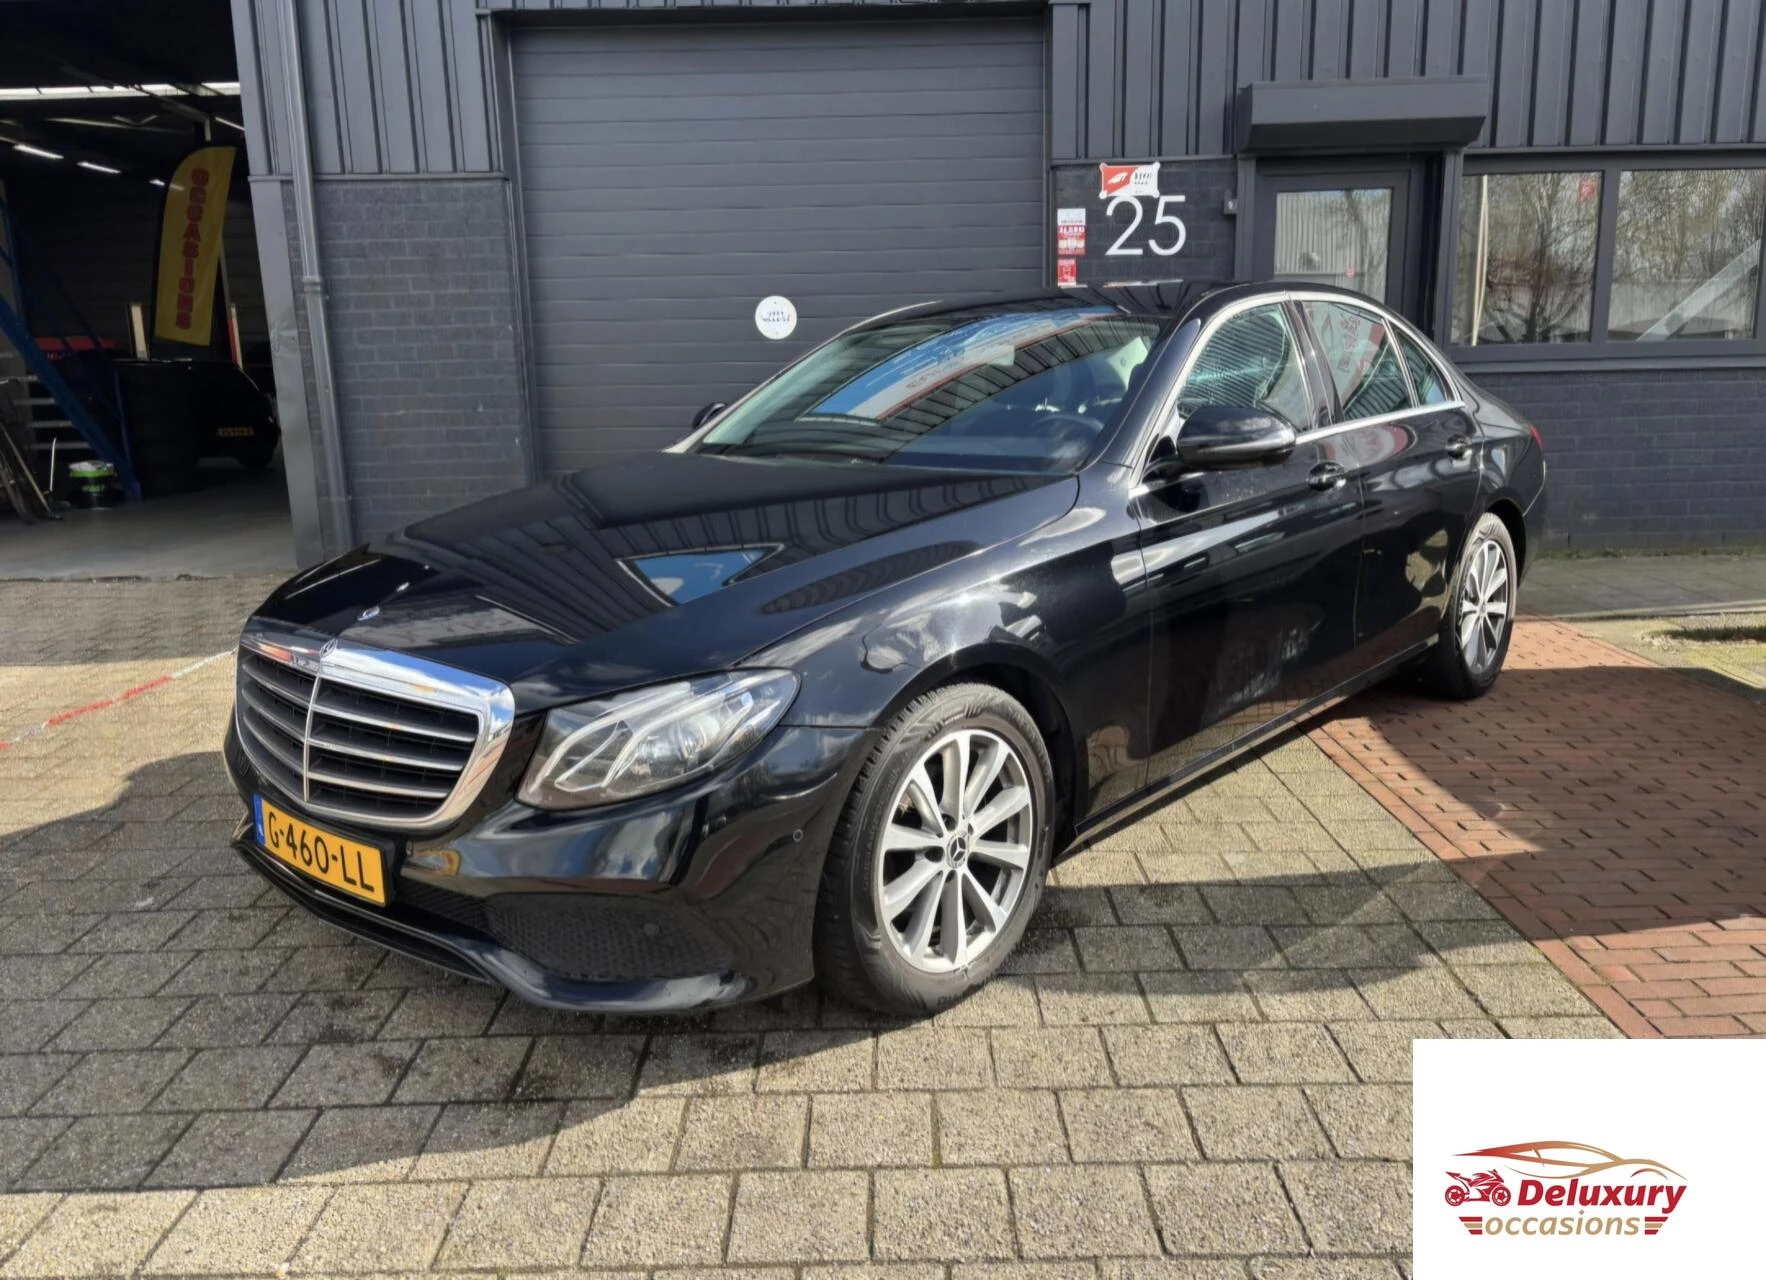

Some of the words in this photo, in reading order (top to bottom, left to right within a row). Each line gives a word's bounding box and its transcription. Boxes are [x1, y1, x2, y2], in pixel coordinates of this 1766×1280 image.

[175, 167, 210, 330] OCCASIONS
[1105, 195, 1187, 256] 25
[268, 811, 375, 893] G-460-LL
